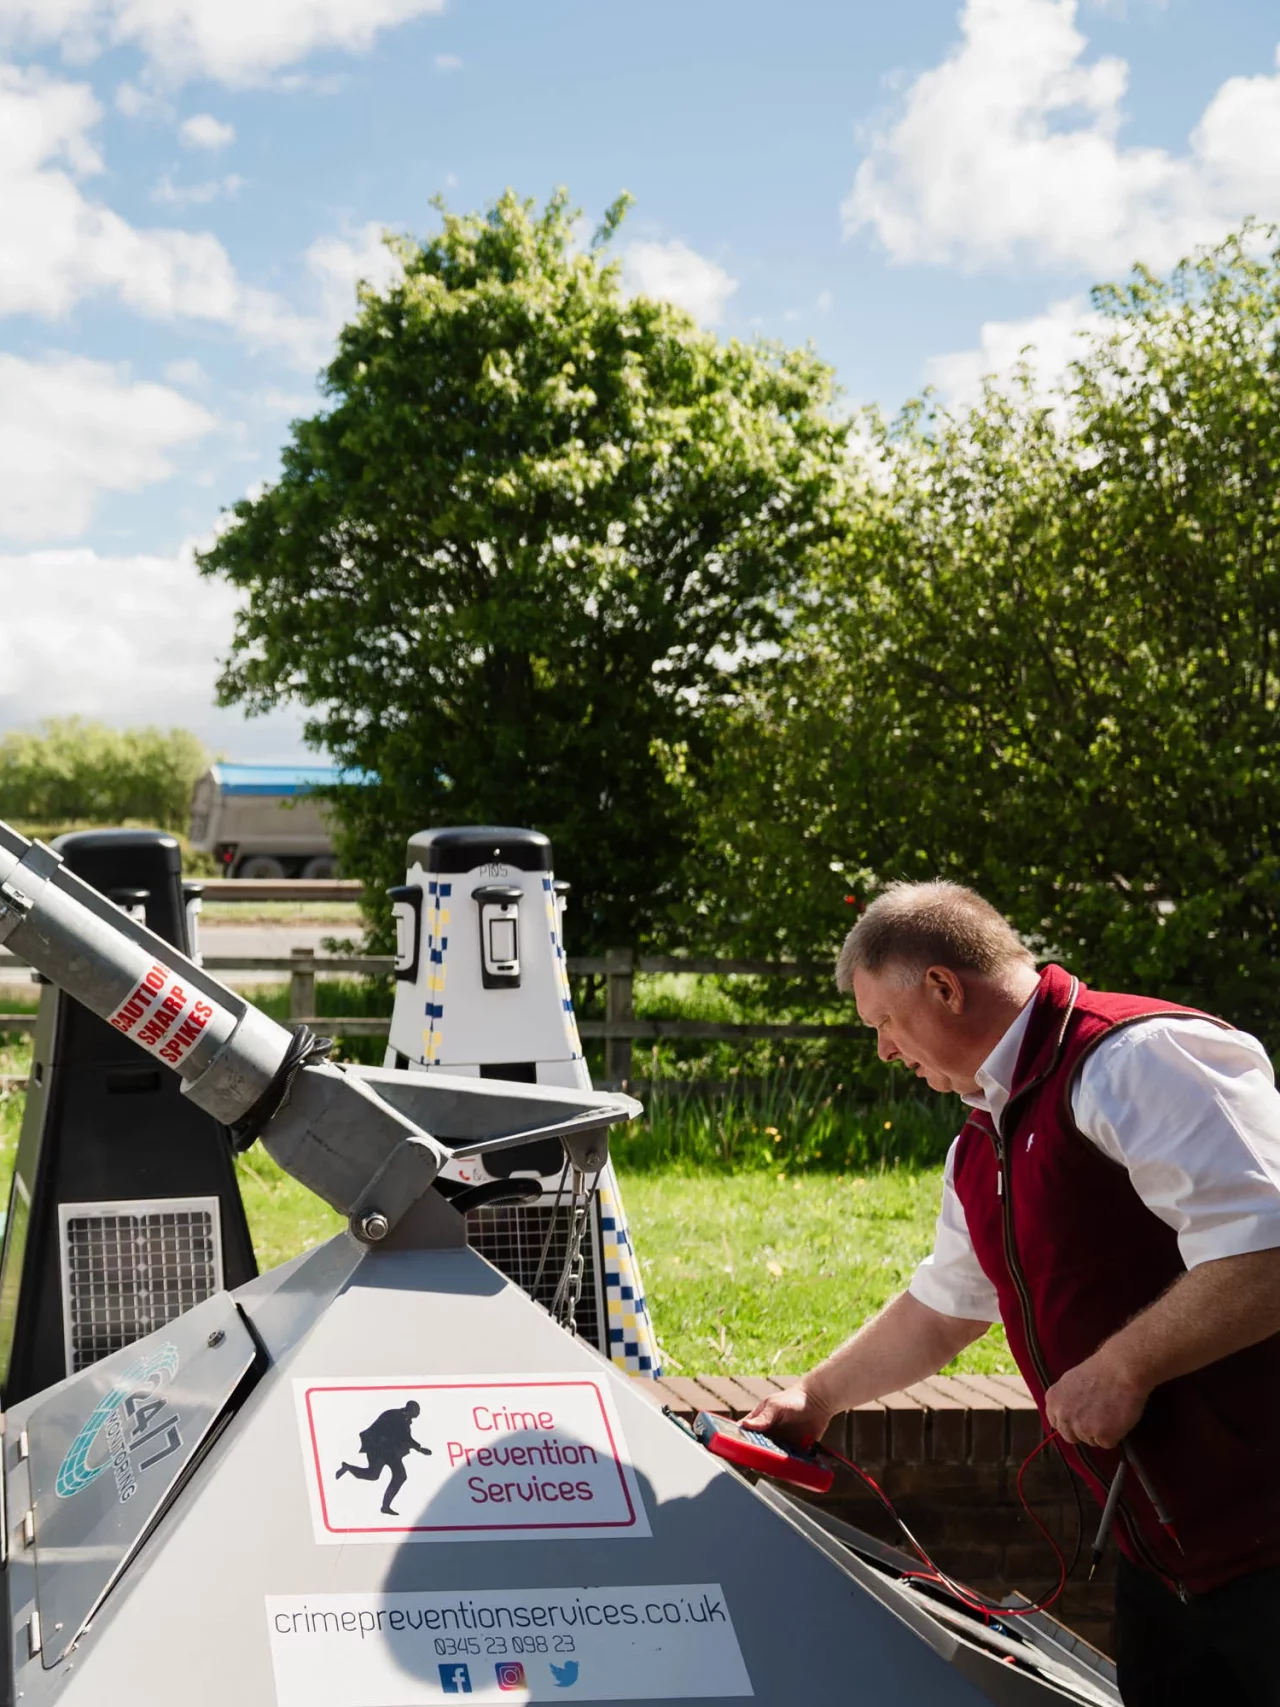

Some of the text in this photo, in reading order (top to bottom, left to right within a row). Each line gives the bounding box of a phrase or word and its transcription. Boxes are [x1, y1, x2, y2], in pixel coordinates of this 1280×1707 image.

[111, 961, 170, 1032] CAUTION
[137, 985, 187, 1045] SHARP
[159, 1001, 213, 1062] SPIKES
[124, 1372, 183, 1472] 24/7
[472, 1406, 555, 1431] Crime
[107, 1410, 136, 1501] MONITORING
[446, 1439, 598, 1467] Prevention
[468, 1476, 593, 1503] Services
[274, 1595, 726, 1639] crimepreventionservices.co.uk
[434, 1634, 576, 1656] 0345 23 098 23
